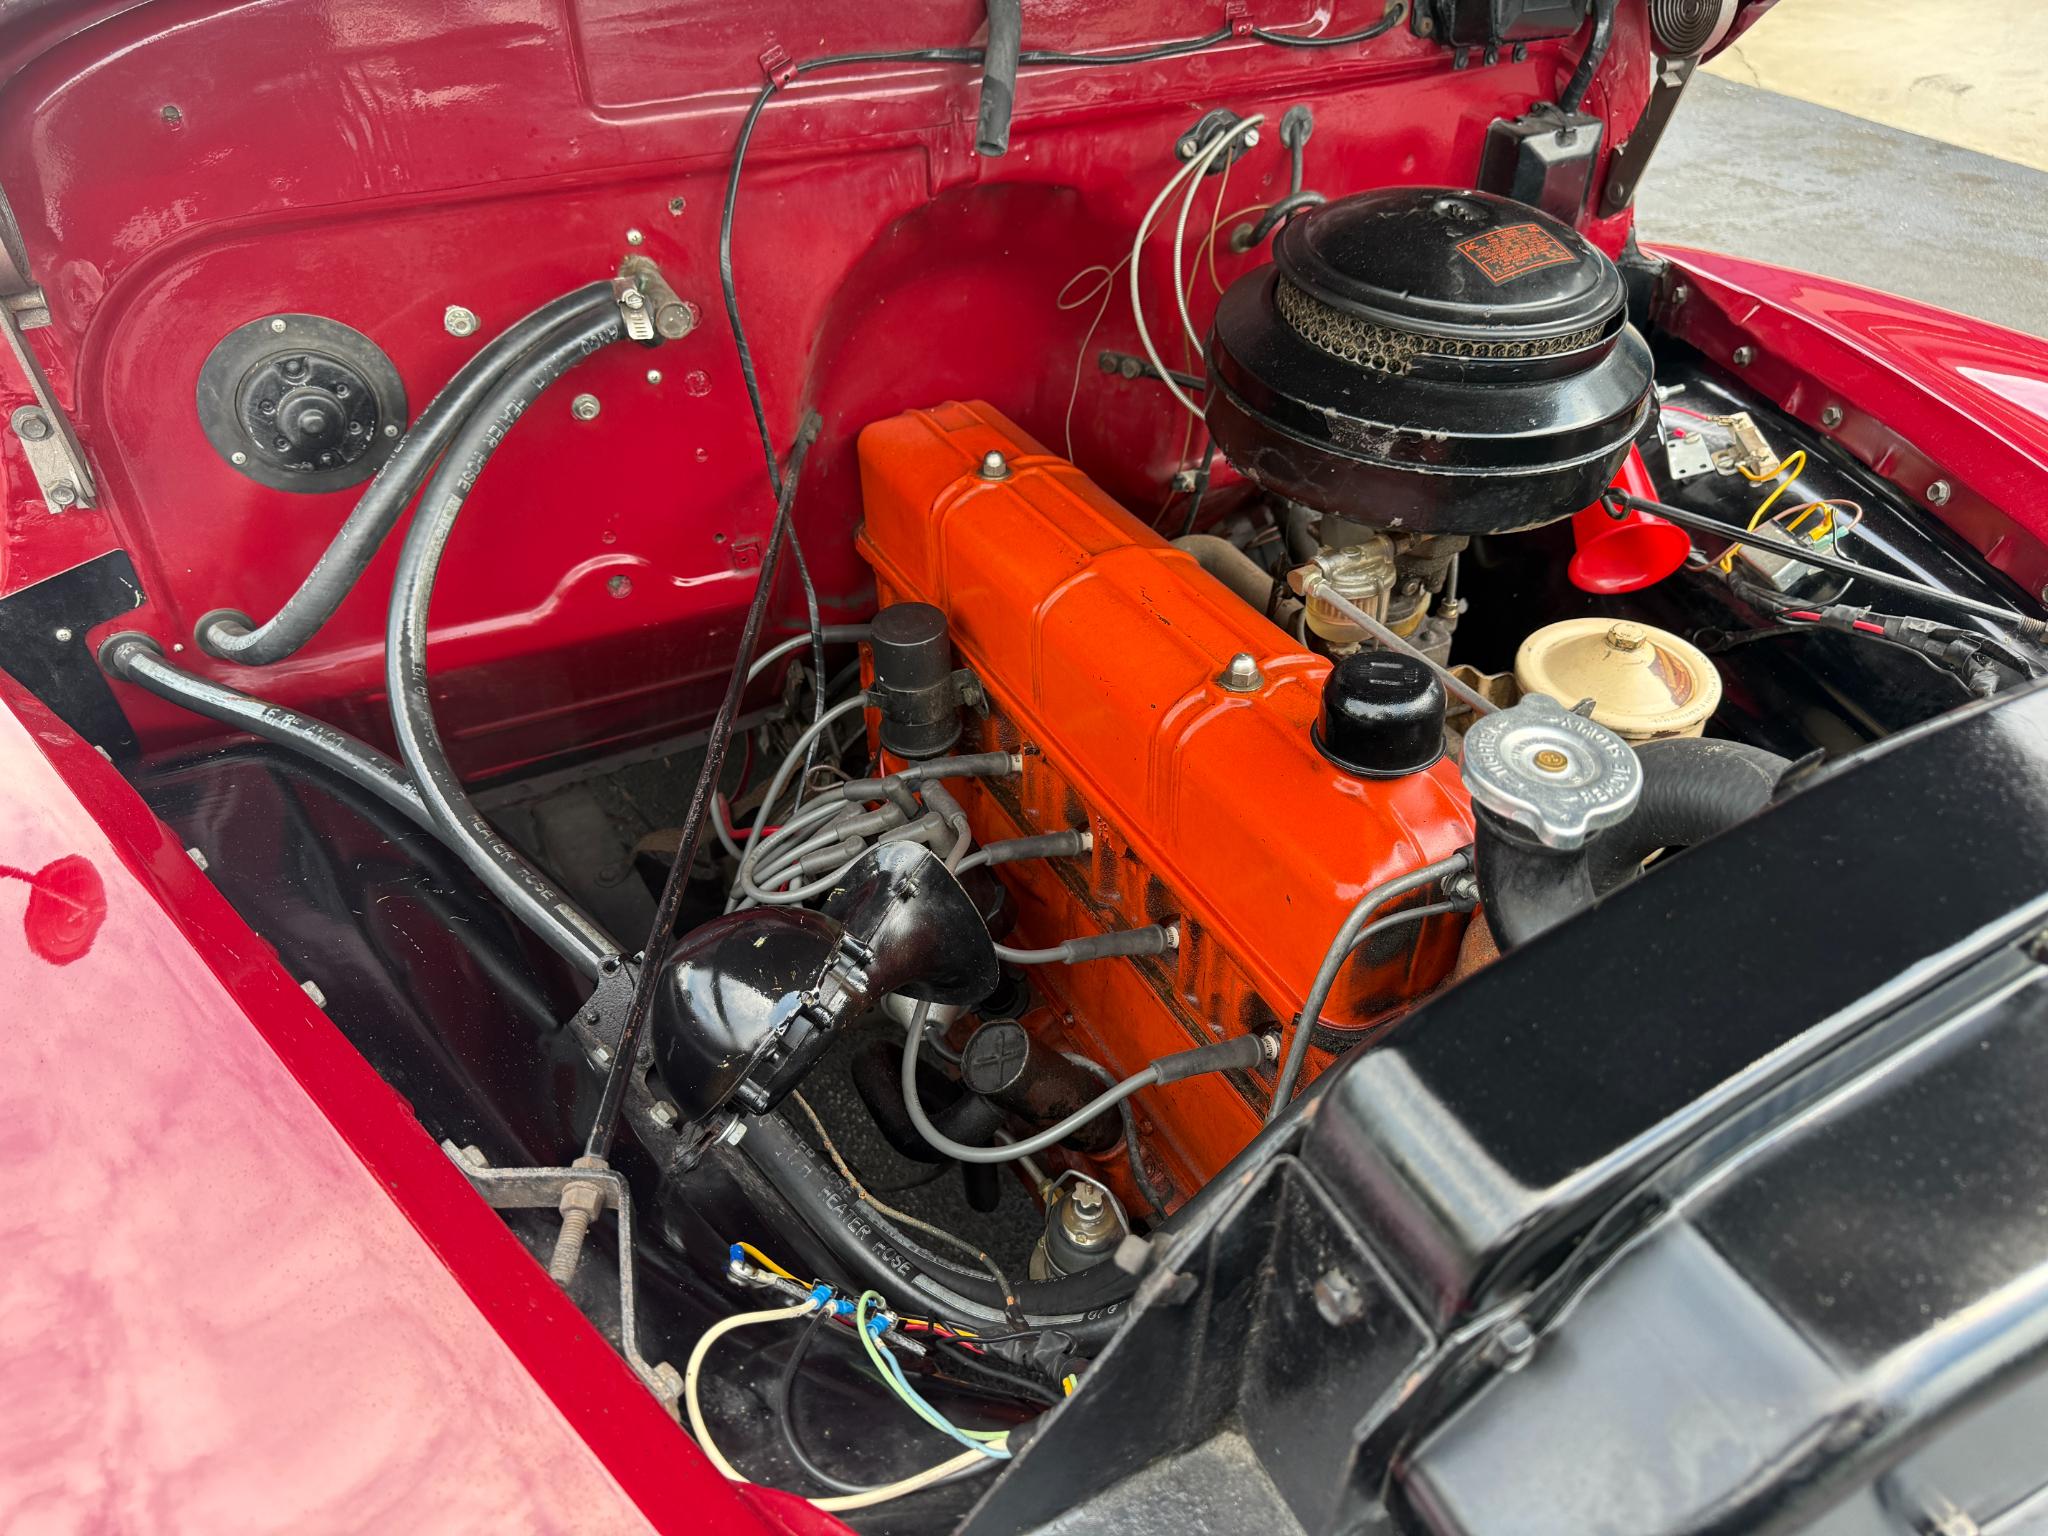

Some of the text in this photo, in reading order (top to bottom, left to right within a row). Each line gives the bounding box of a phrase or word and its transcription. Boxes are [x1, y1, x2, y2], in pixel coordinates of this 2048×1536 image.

[457, 398, 529, 493] HEATER HOSE
[467, 814, 518, 862] HEATER
[817, 1186, 914, 1277] HEATER HOSE
